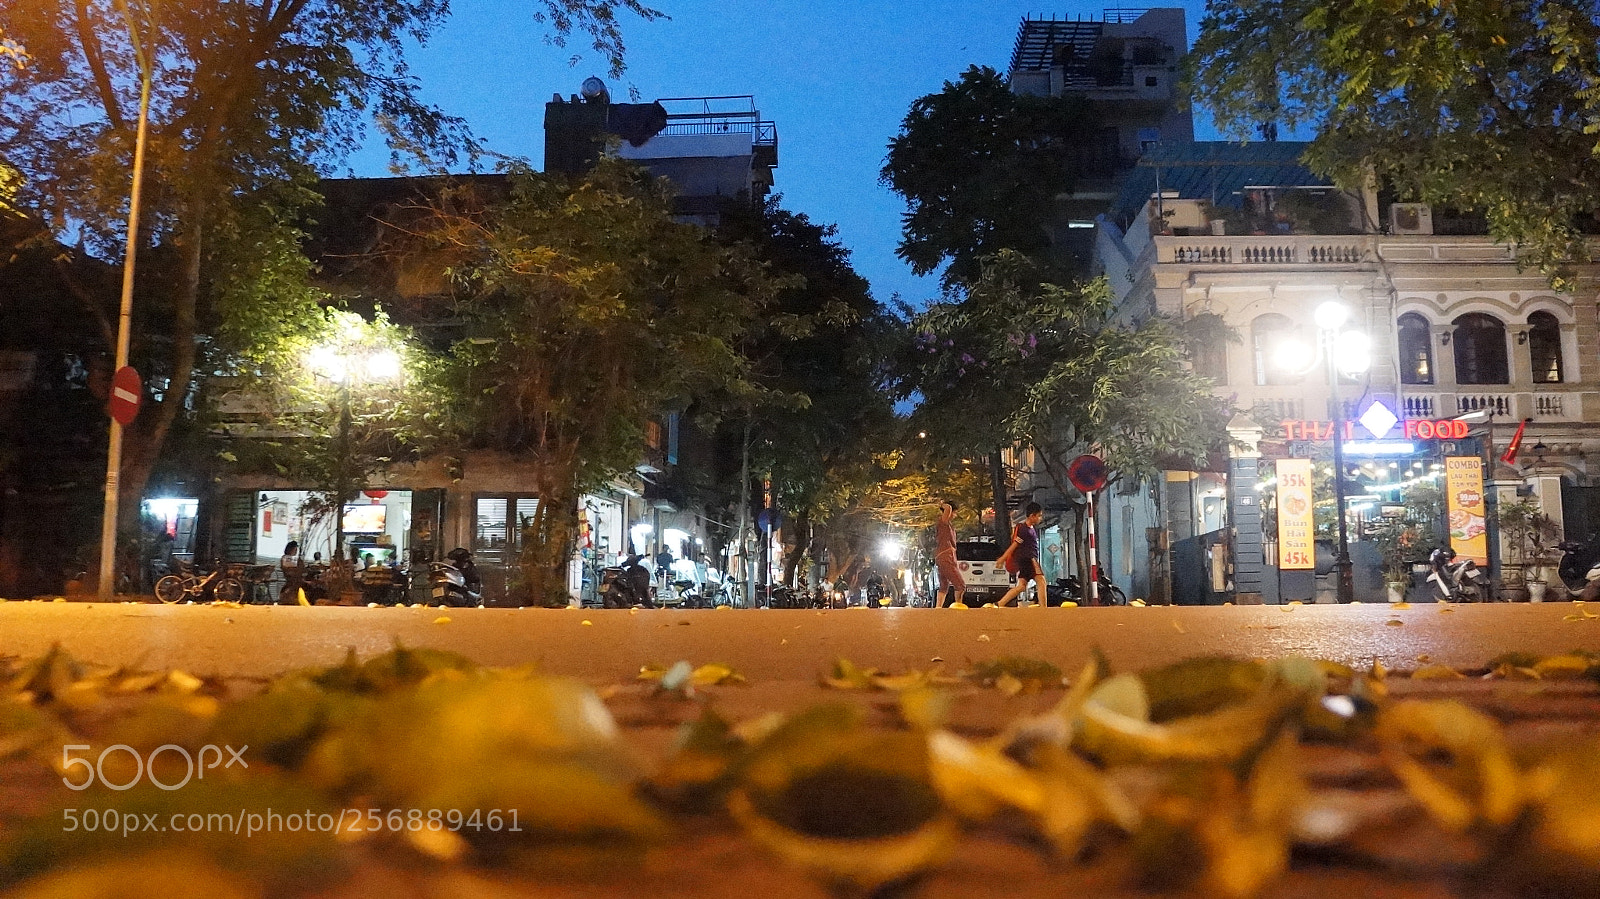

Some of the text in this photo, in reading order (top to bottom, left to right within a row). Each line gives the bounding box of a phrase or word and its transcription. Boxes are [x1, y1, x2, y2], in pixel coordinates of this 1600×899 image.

[1404, 419, 1469, 440] FOOD
[1449, 460, 1479, 469] COMBO
[1282, 473, 1306, 487] 35k
[1284, 551, 1309, 565] 45k
